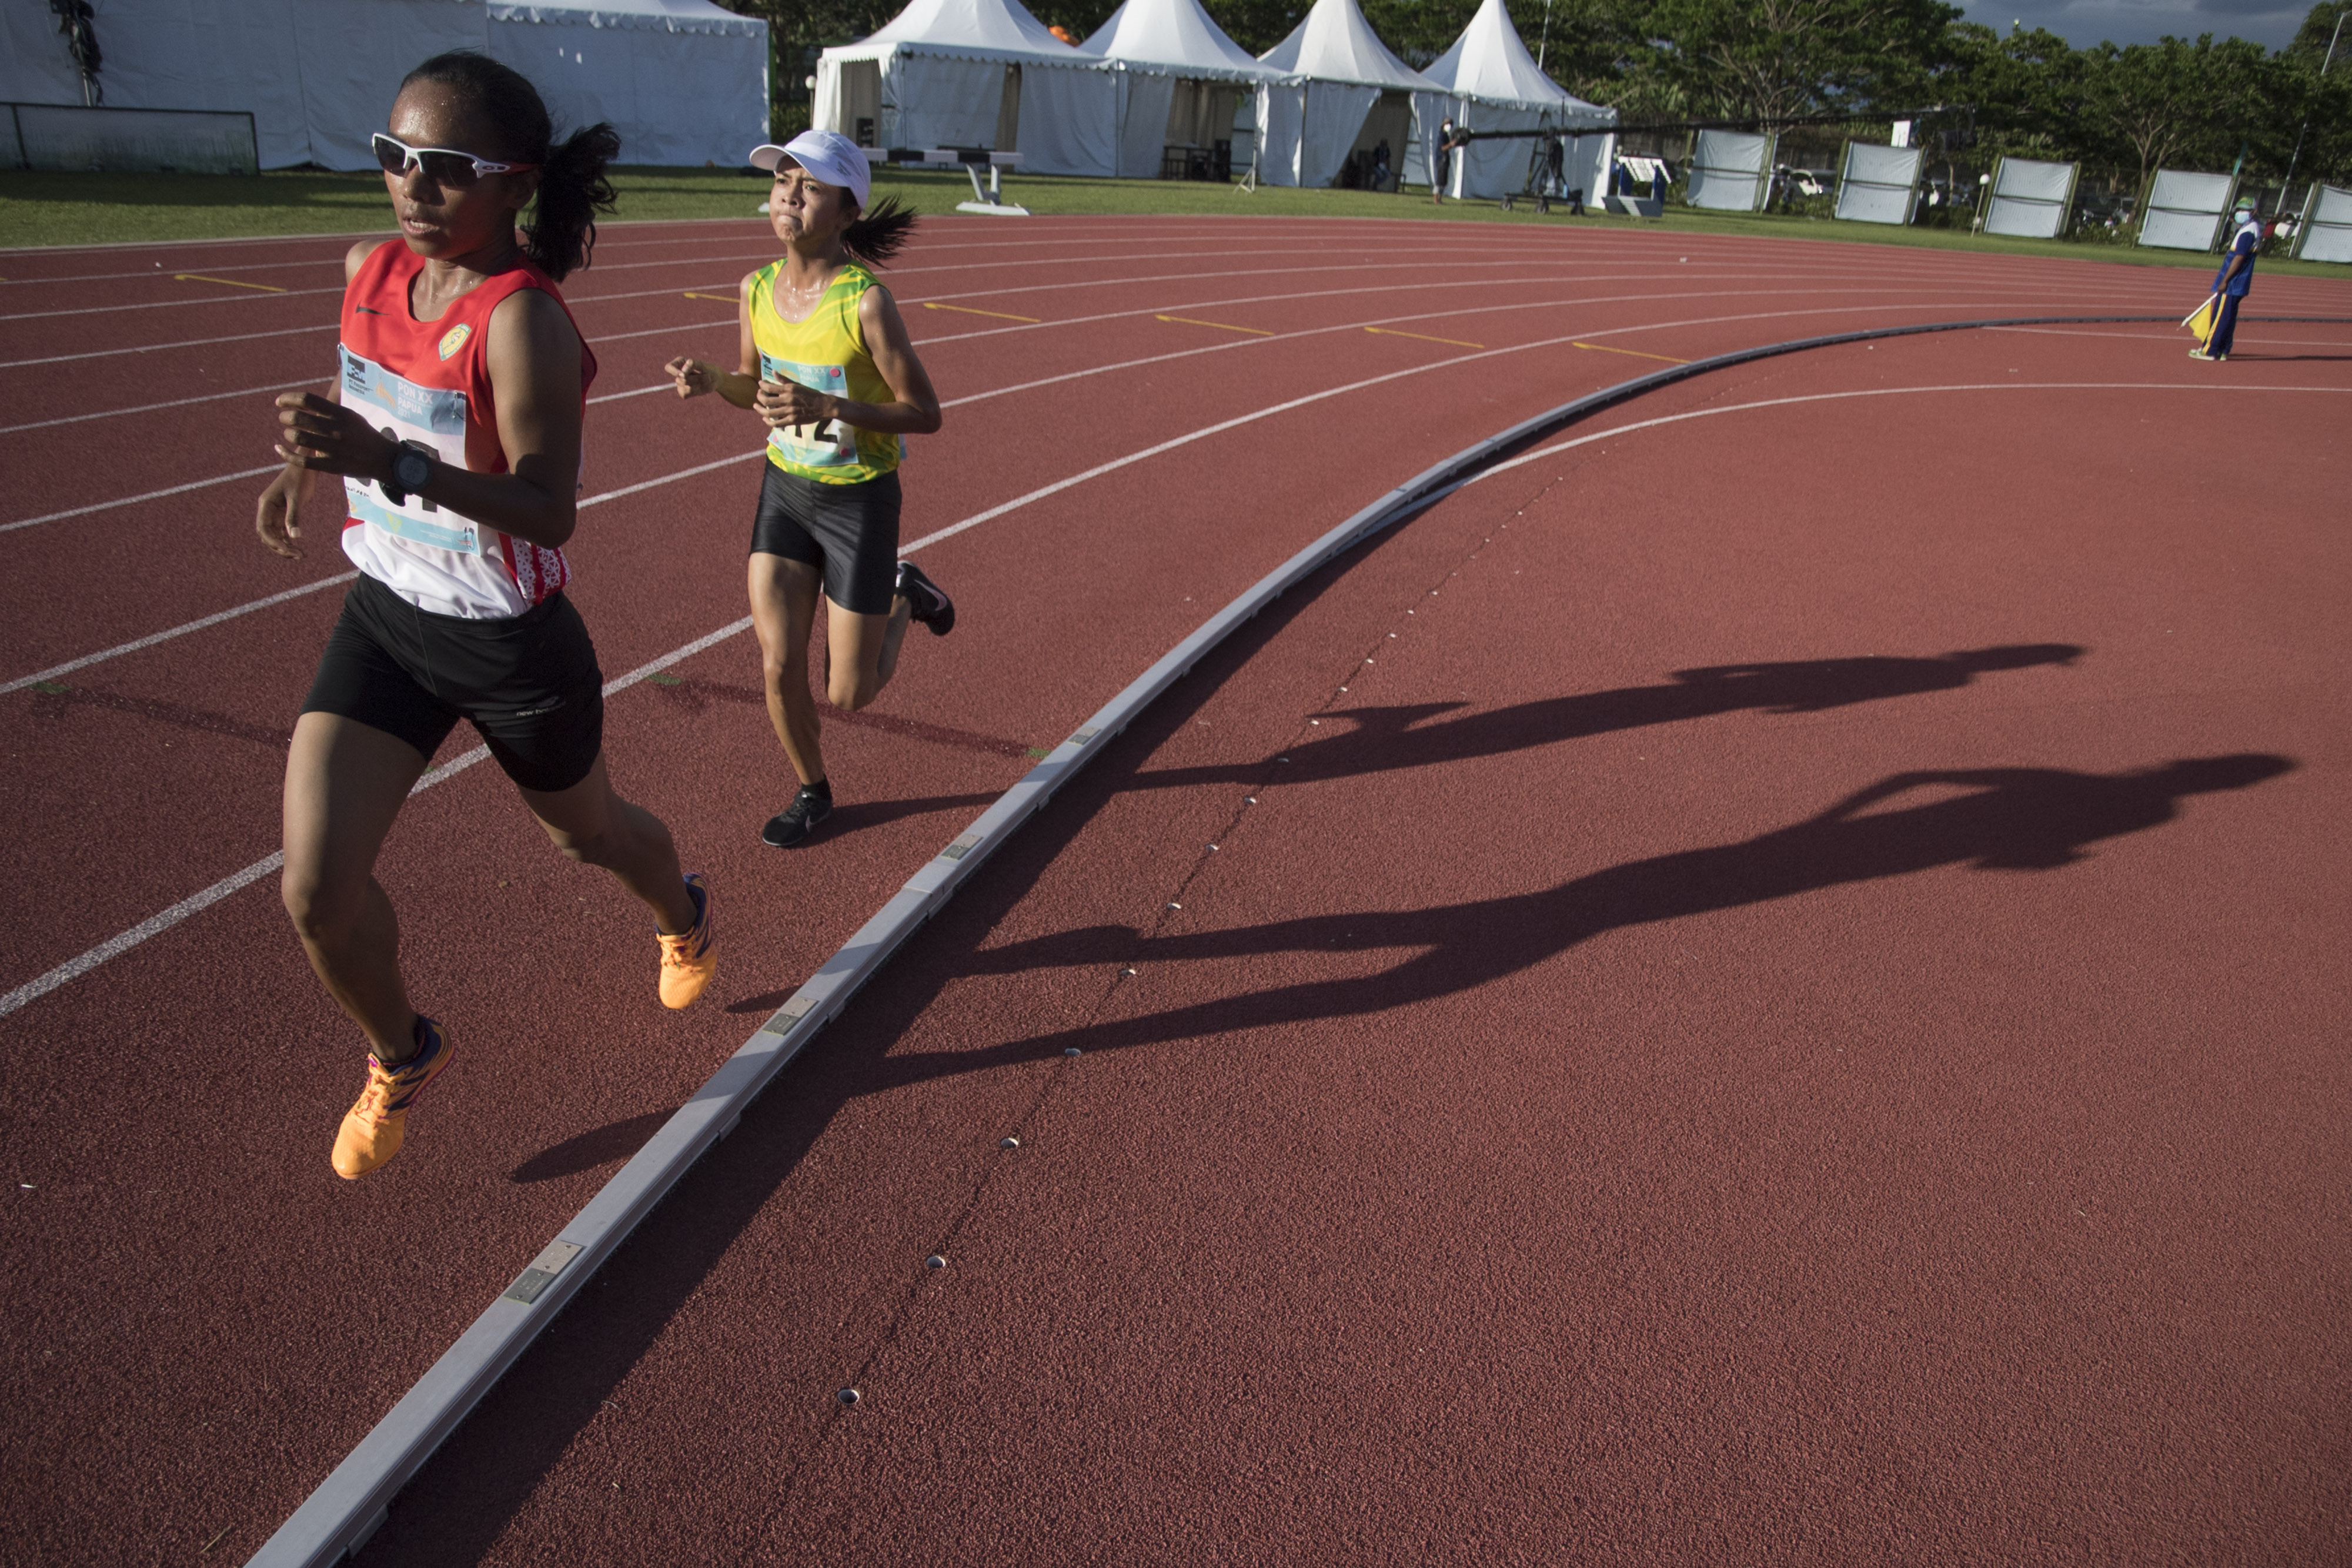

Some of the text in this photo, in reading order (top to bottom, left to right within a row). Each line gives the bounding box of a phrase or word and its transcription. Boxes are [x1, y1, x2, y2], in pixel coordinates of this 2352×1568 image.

[397, 381, 416, 399] PON
[418, 390, 433, 404] XX
[398, 396, 423, 415] PAPUA
